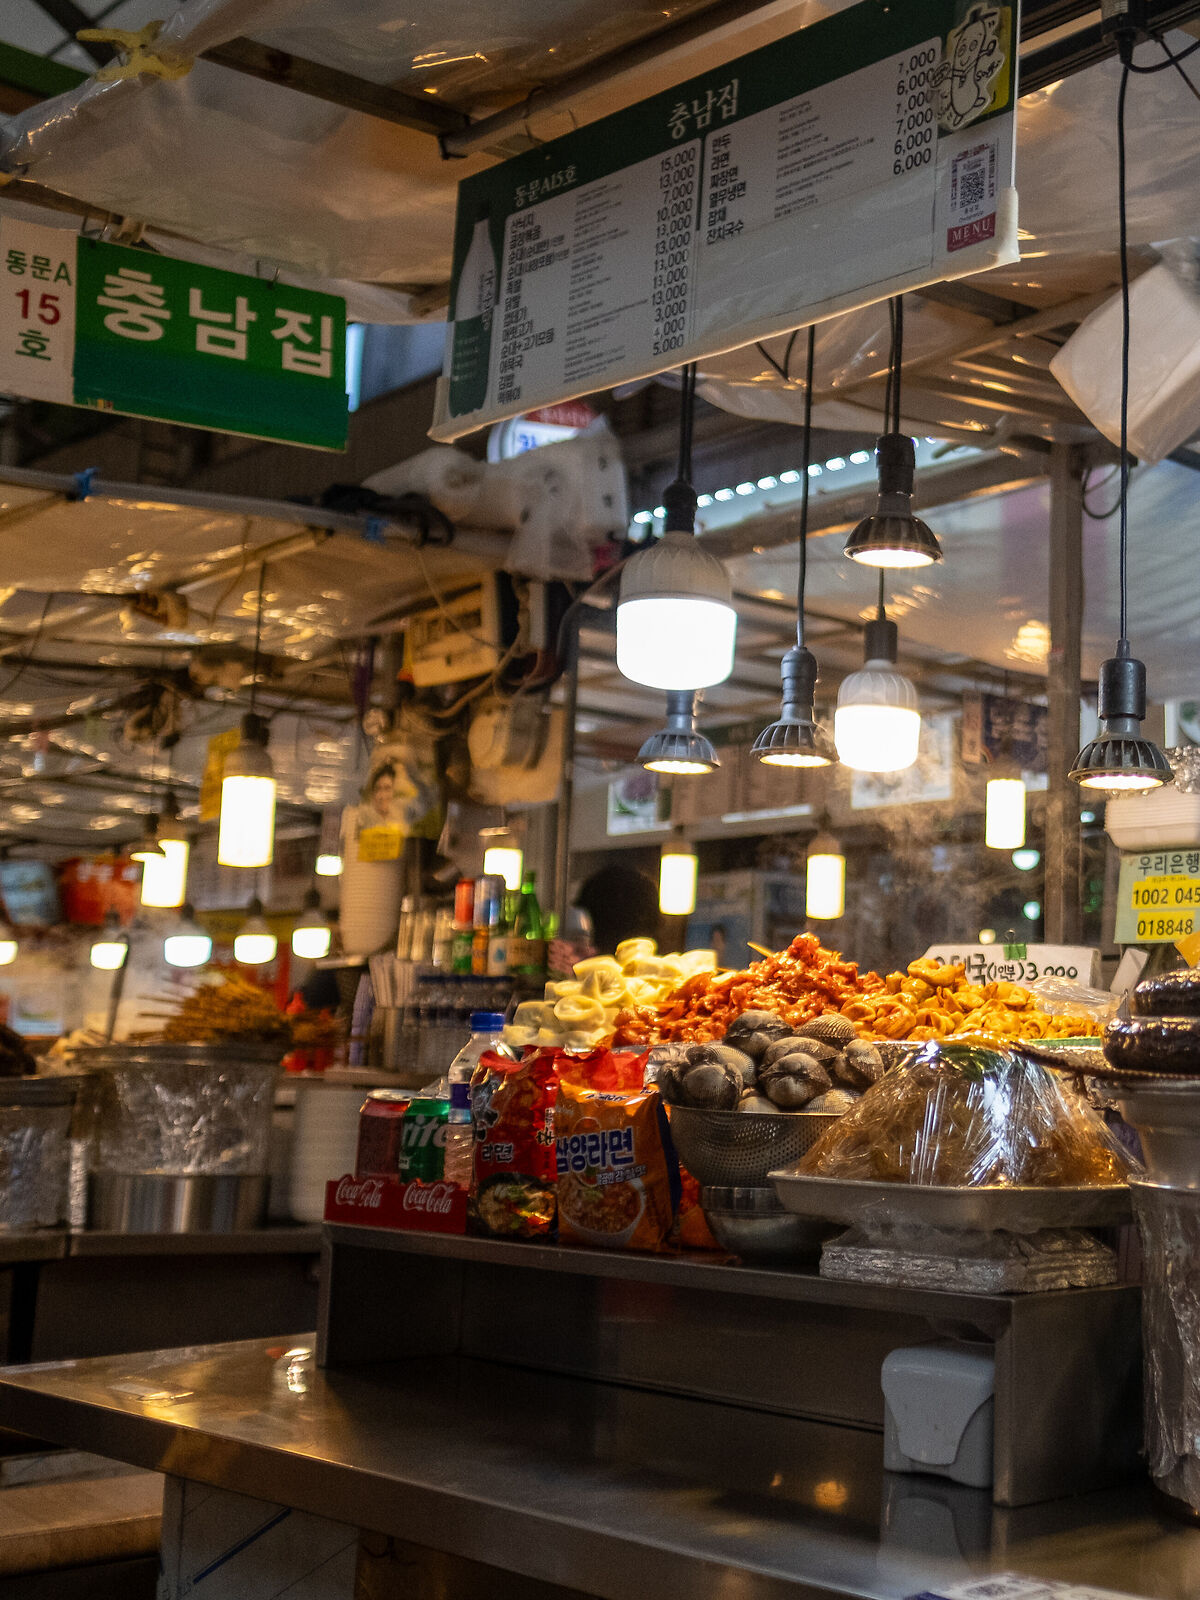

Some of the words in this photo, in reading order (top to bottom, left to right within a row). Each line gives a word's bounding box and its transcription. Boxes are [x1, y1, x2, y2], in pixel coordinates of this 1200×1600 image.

[897, 48, 936, 74] 7,000
[665, 78, 739, 140] 충남집
[895, 107, 934, 135] 7,000
[893, 127, 932, 155] 6,000
[660, 147, 696, 173] 15,000
[710, 151, 730, 171] 라면
[659, 164, 695, 189] 13,000
[663, 181, 694, 204] 7,000
[706, 219, 744, 245] 잔치국수
[893, 147, 932, 175] 6,000
[656, 197, 693, 222] 10,000
[656, 214, 692, 239] 13,000
[952, 218, 992, 243] MENU
[655, 231, 690, 256] 13,000
[5, 249, 72, 287] 동문A
[654, 248, 689, 273] 13,000
[652, 265, 689, 290] 13,000
[651, 282, 687, 306] 13,000
[15, 288, 61, 326] 15
[653, 299, 687, 322] 3,000
[97, 267, 334, 379] 충남집
[14, 328, 53, 361] 호
[652, 333, 685, 356] 5,000
[1138, 852, 1200, 876] 우리은행
[1133, 888, 1169, 906] 1002
[1137, 918, 1194, 936] 018848
[556, 1125, 636, 1175] 삼양라면
